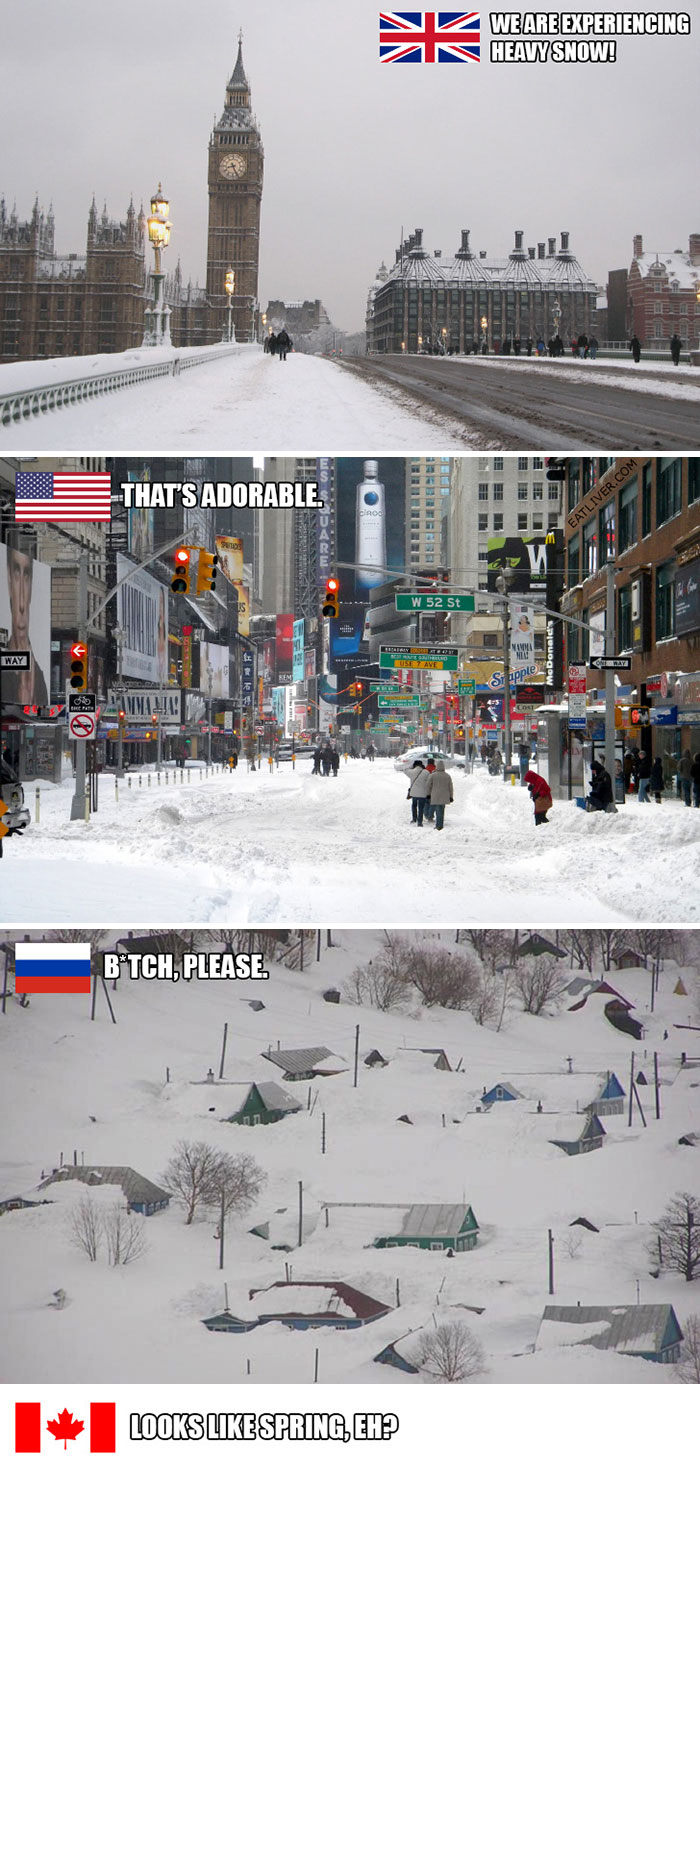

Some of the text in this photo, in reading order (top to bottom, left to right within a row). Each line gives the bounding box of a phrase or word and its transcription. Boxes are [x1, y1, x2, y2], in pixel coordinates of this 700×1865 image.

[411, 597, 461, 608] W 52 St
[511, 643, 533, 652] MAMMA
[516, 651, 529, 660] MIA!
[5, 657, 24, 665] WAY
